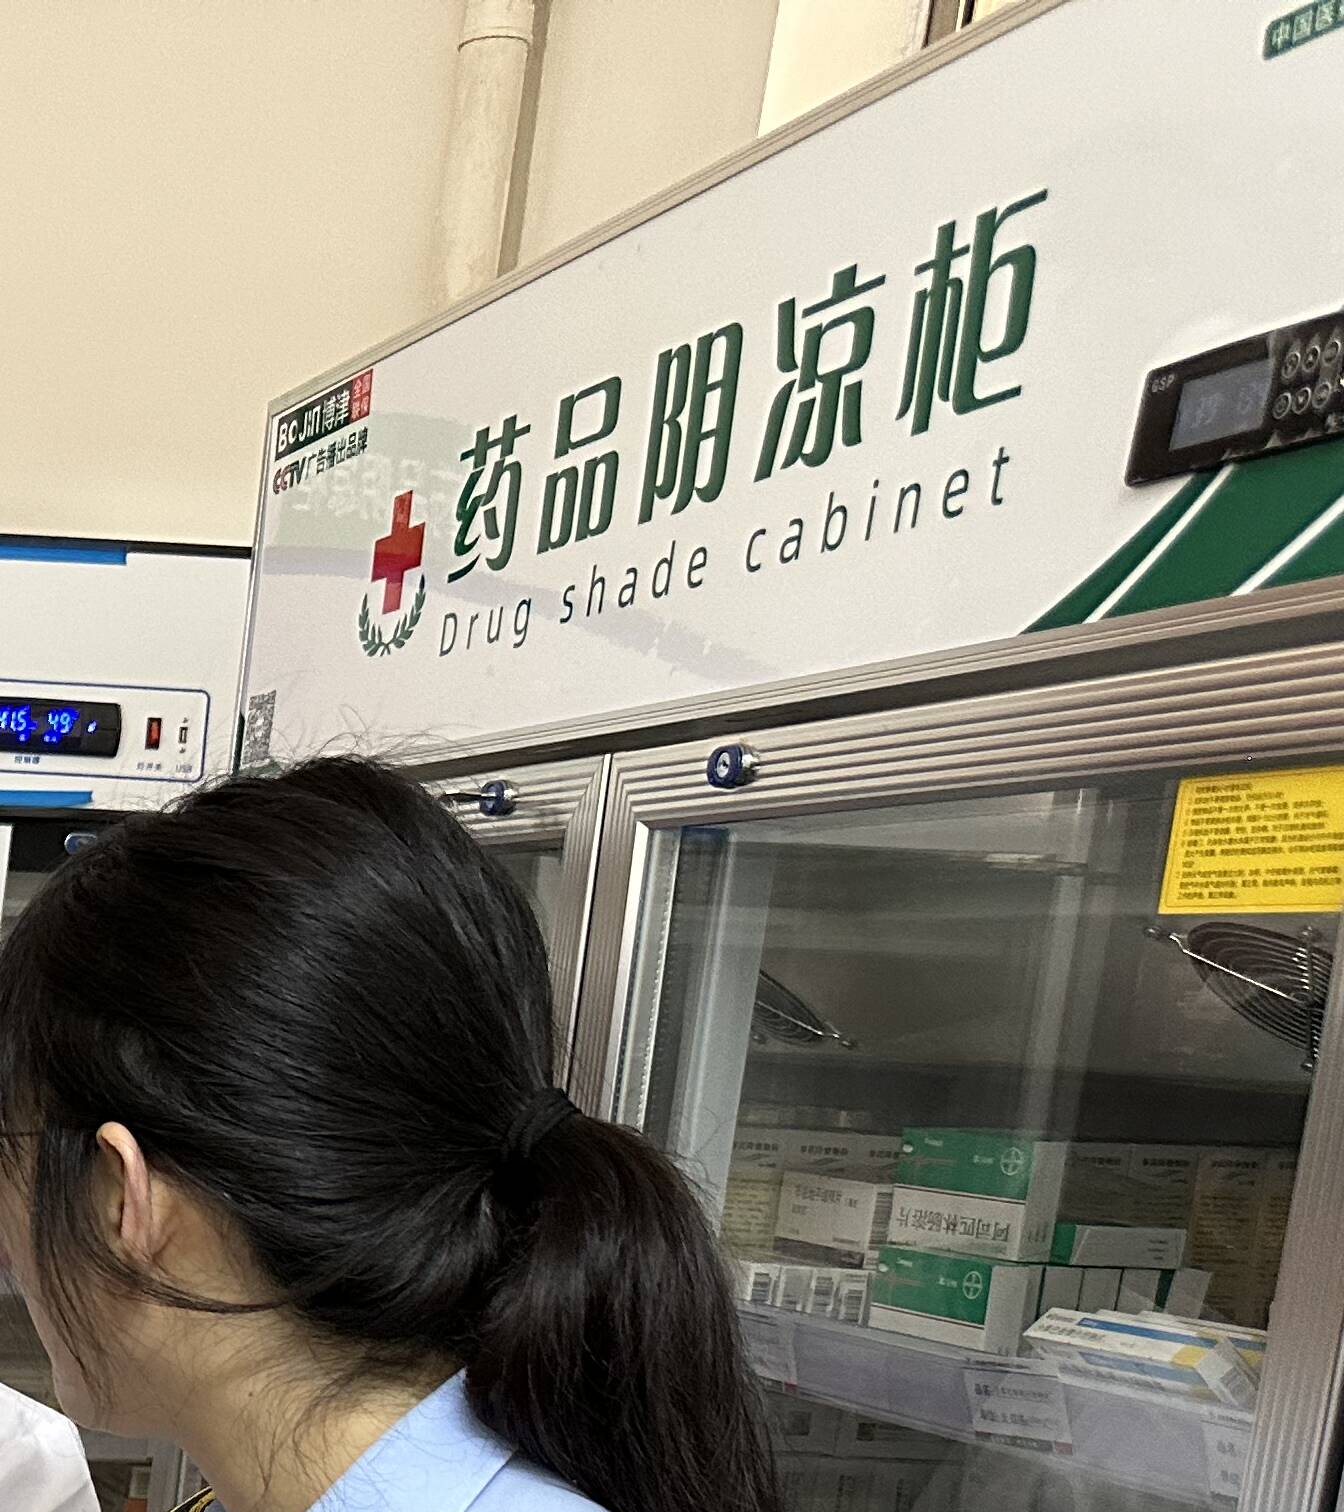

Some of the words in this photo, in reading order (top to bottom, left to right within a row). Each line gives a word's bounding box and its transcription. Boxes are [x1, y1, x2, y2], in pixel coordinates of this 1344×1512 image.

[448, 188, 1048, 584] 药品阴凉柜
[438, 597, 532, 657] Drug
[560, 541, 709, 625] shade
[745, 445, 1013, 574] cabinet
[895, 1206, 1010, 1243] 阿司匹林肠溶片
